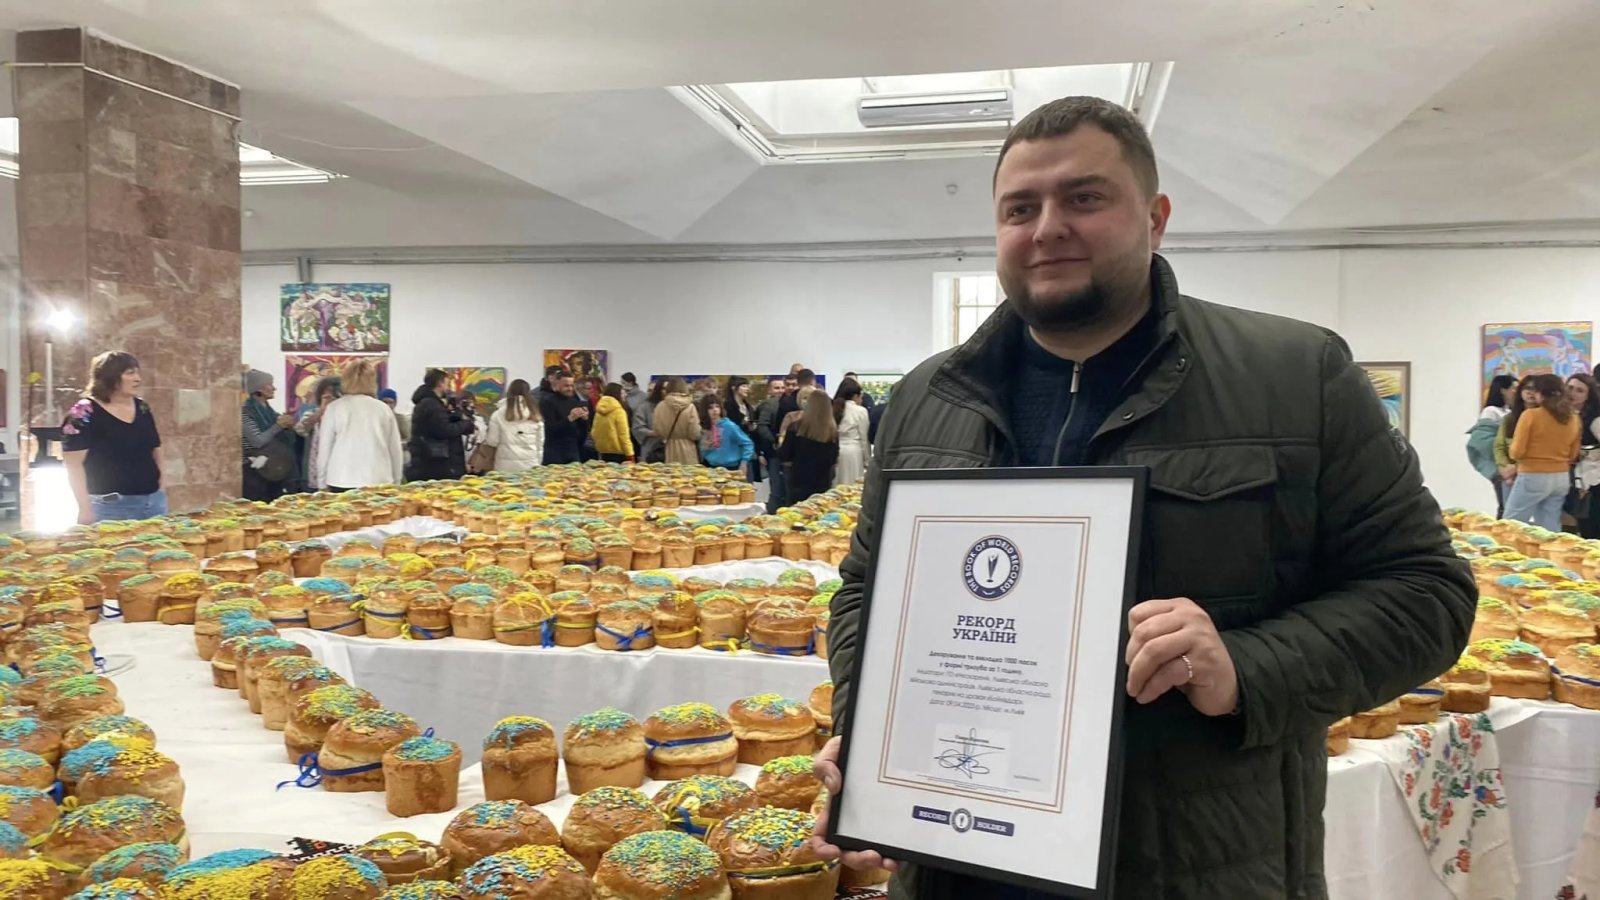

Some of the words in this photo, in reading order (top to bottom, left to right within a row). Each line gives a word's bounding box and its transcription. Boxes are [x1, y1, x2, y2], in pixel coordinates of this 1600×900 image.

[975, 541, 987, 552] OF
[987, 539, 1014, 554] WORLD
[965, 551, 977, 577] BOOK
[1000, 554, 1019, 593] RECORDS
[967, 577, 980, 592] THE
[957, 615, 1016, 631] РЕКОРД
[952, 628, 1018, 644] УКРАЇНИ
[918, 810, 948, 821] RECORD
